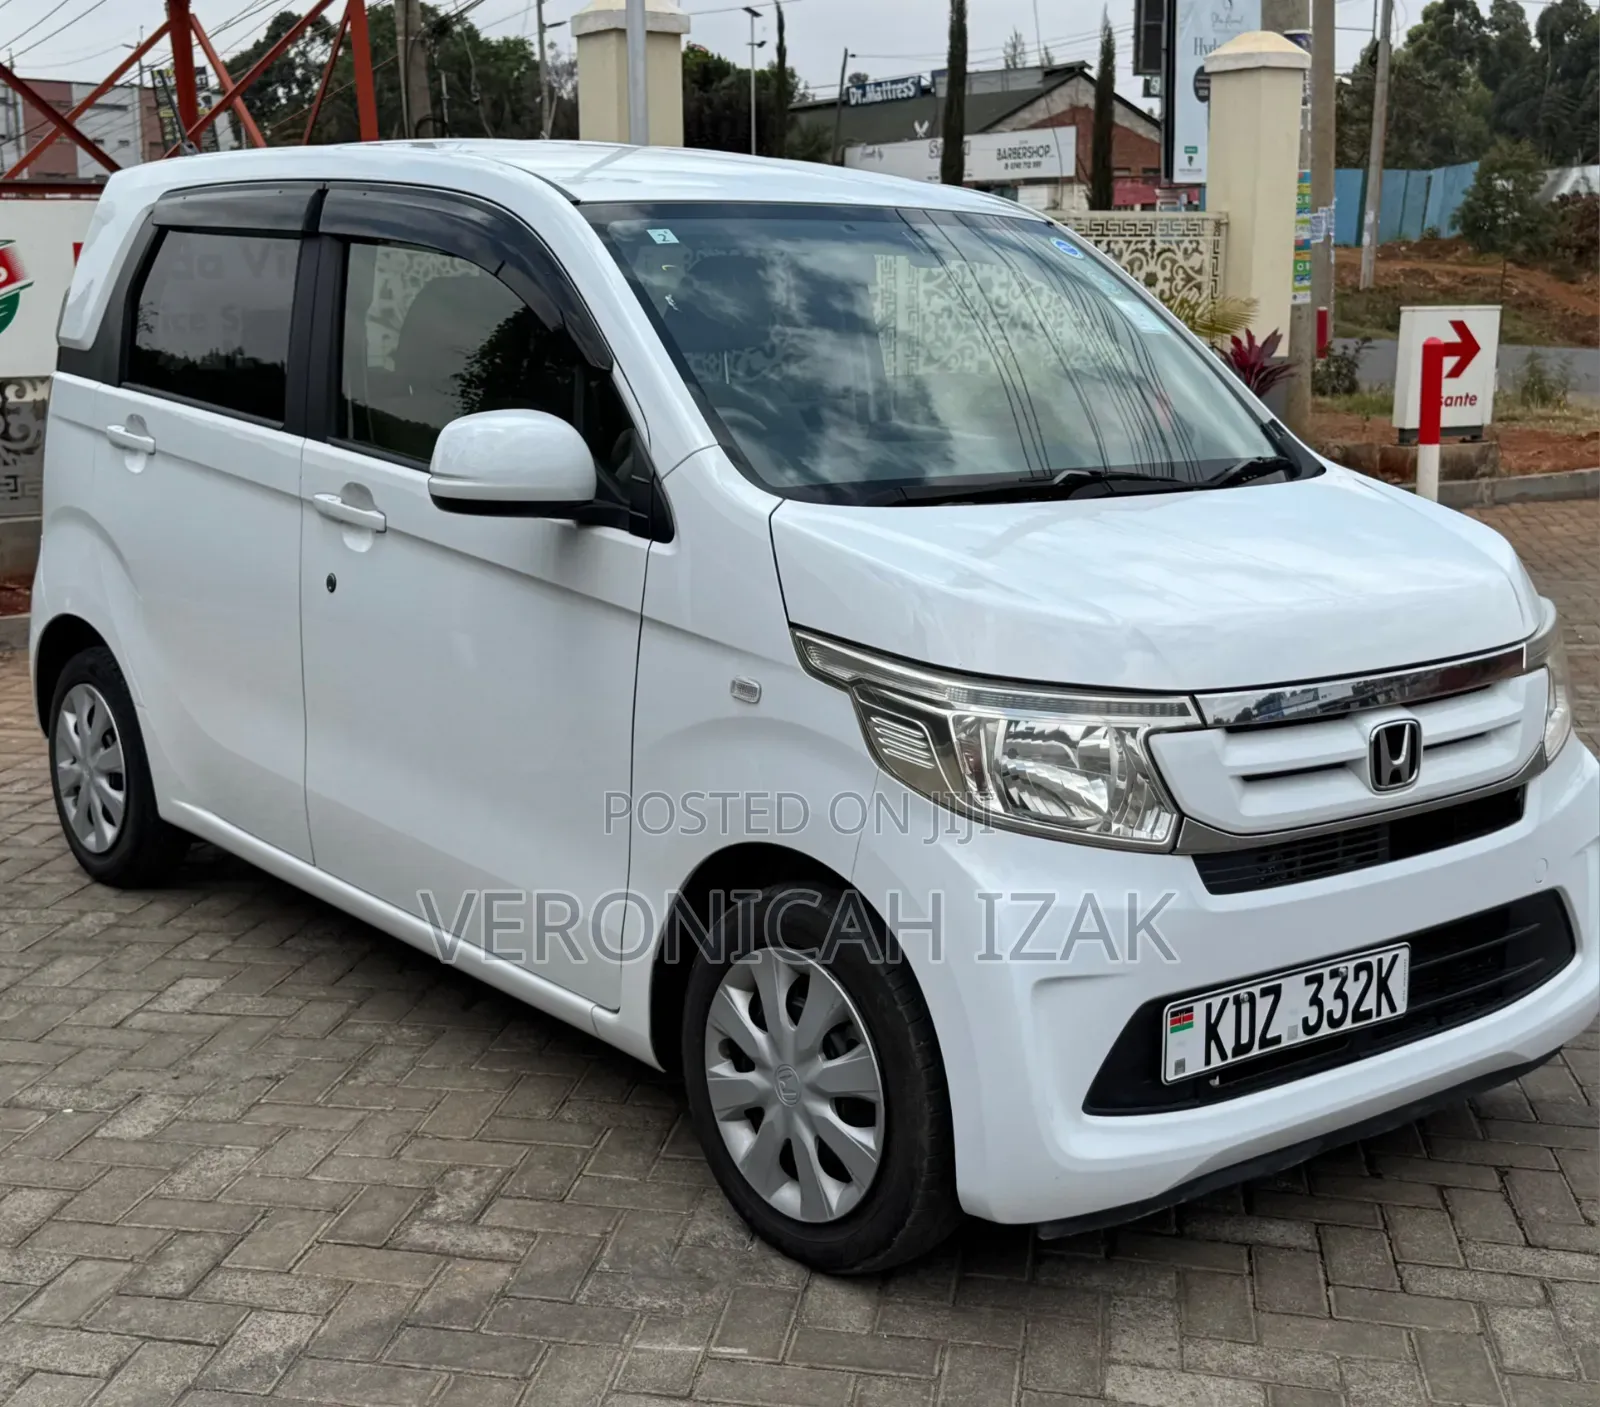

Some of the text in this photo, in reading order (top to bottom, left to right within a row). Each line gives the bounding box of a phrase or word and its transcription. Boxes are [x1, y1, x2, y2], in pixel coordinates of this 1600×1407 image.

[1194, 37, 1221, 57] Hyd
[996, 144, 1051, 160] BARBERSHOP
[1204, 983, 1283, 1067] KDZ
[1301, 953, 1400, 1036] 332K
